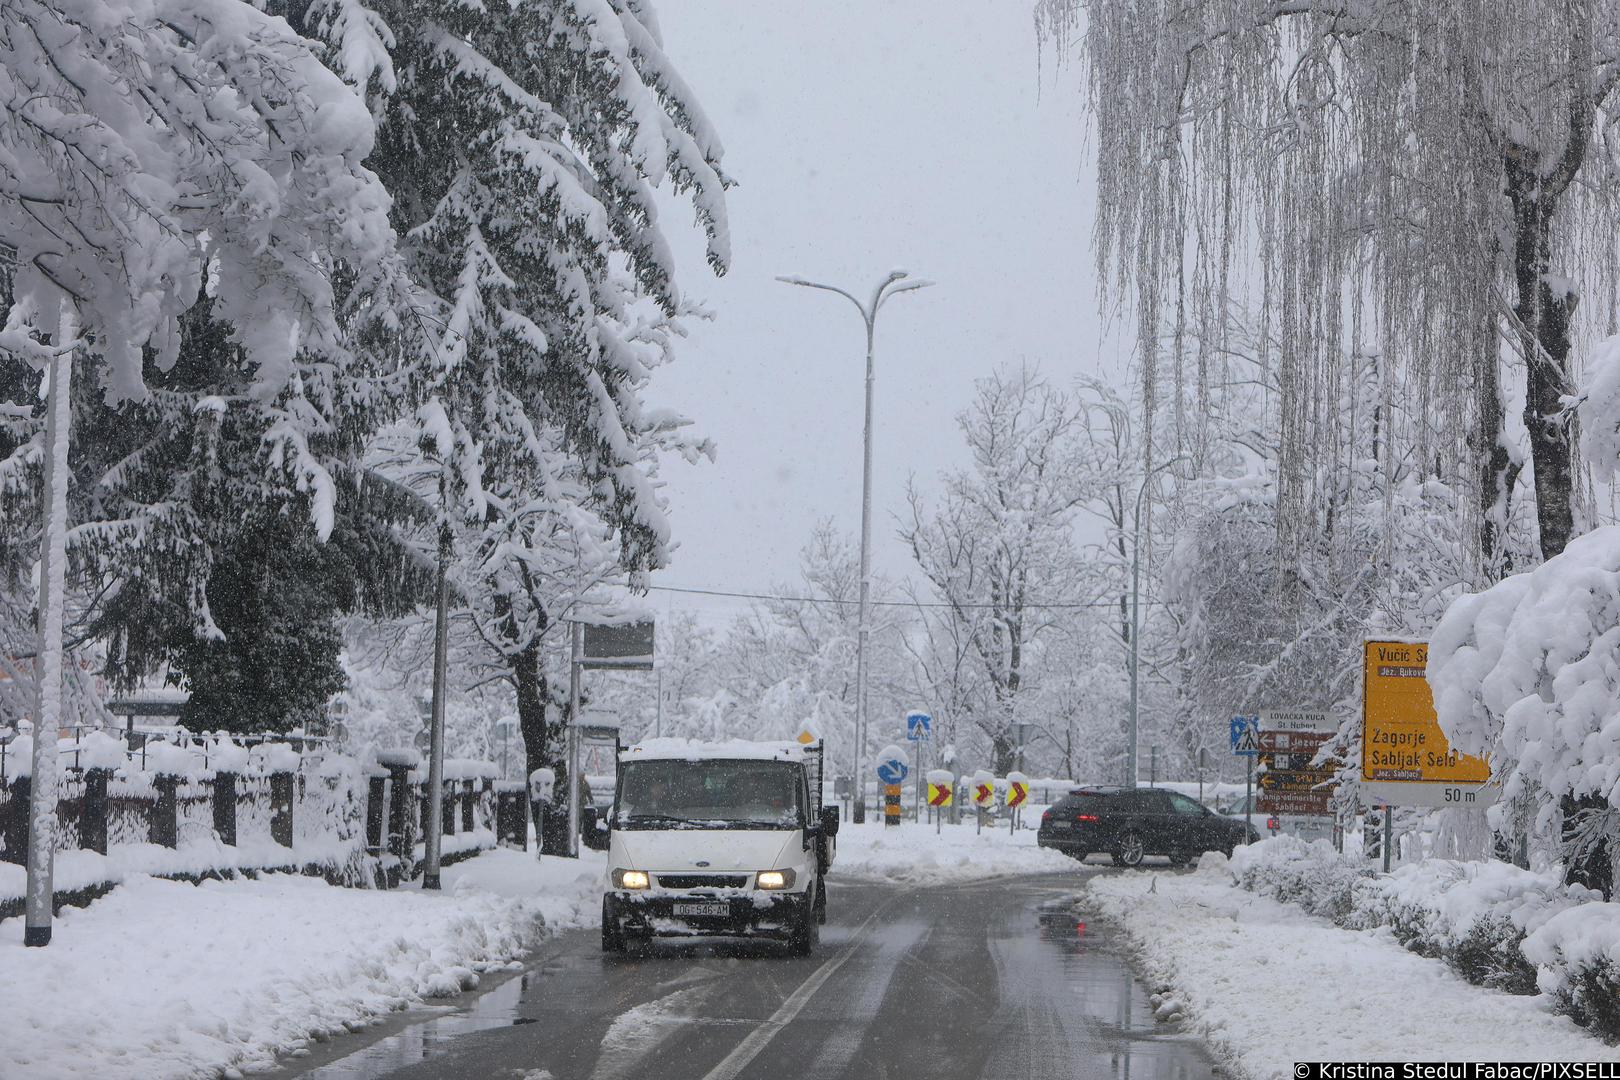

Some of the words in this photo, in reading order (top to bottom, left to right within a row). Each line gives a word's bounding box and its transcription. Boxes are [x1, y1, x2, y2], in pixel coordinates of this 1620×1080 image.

[1378, 647, 1410, 662] Vučić
[1372, 728, 1425, 747] Zagorje
[1372, 750, 1421, 770] Sabljak
[1427, 751, 1456, 768] Selo
[1445, 788, 1461, 802] 50
[1465, 791, 1475, 802] m
[1275, 803, 1307, 813] Sabljaci
